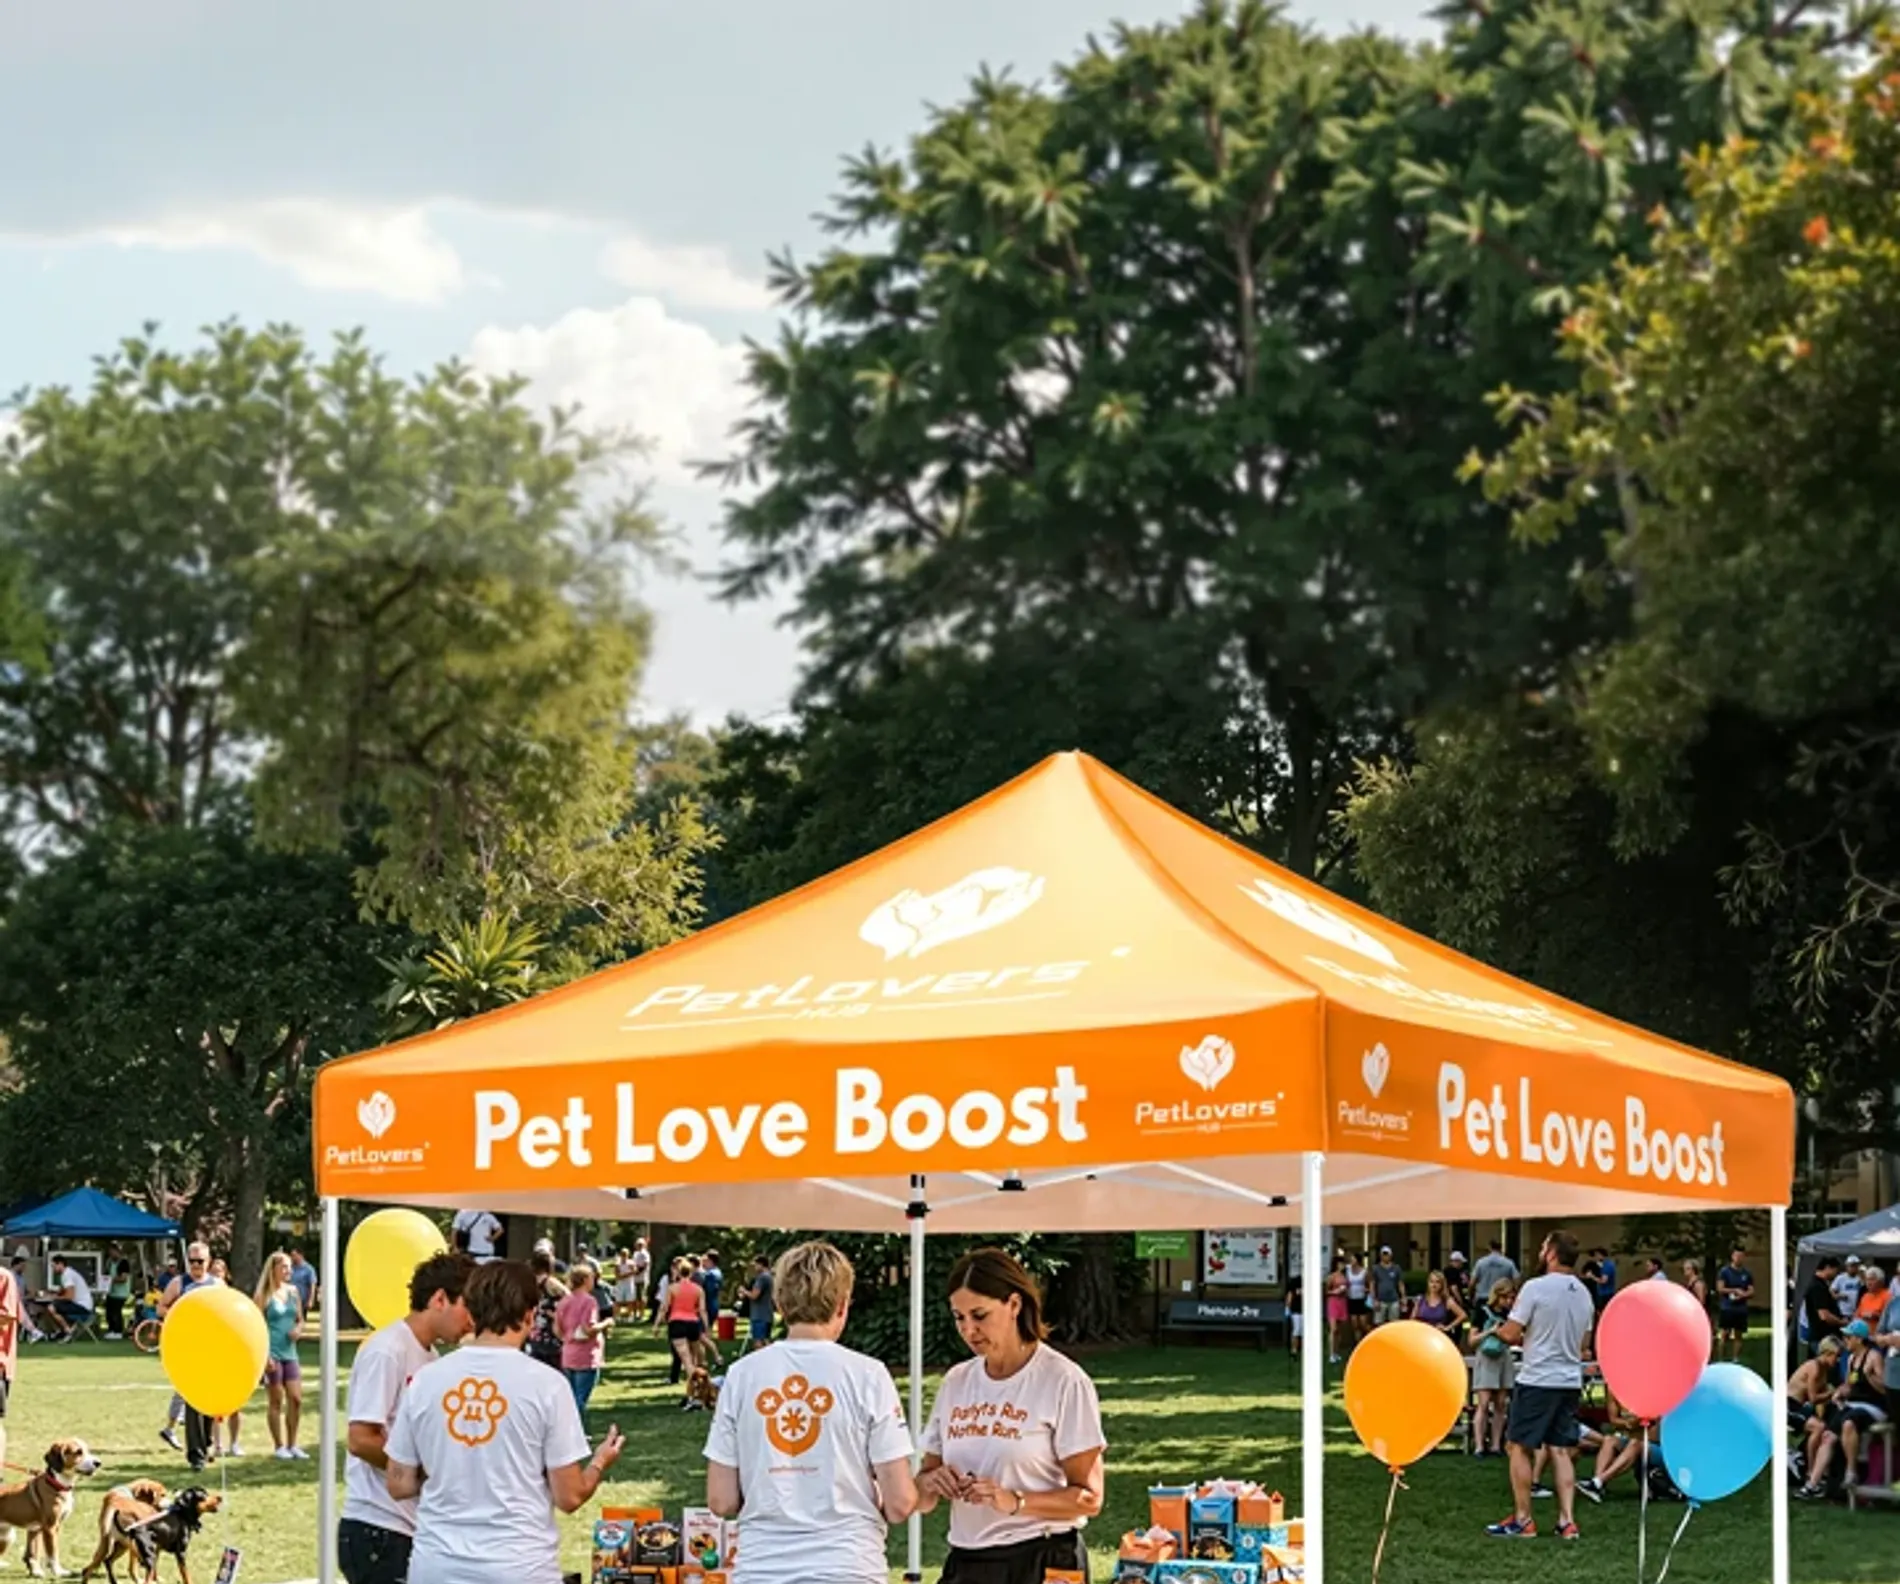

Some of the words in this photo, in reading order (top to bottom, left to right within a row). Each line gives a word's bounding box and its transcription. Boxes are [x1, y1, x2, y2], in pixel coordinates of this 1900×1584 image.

[627, 960, 1092, 1018] PetLovers
[474, 1090, 593, 1170] Pet
[616, 1082, 809, 1164] Love
[834, 1065, 1088, 1154] Boost
[1135, 1099, 1277, 1125] PetLovers
[1437, 1062, 1509, 1159] Pet
[1519, 1076, 1616, 1173] Love
[1625, 1096, 1728, 1187] Boost
[324, 1145, 424, 1166] PetLovers
